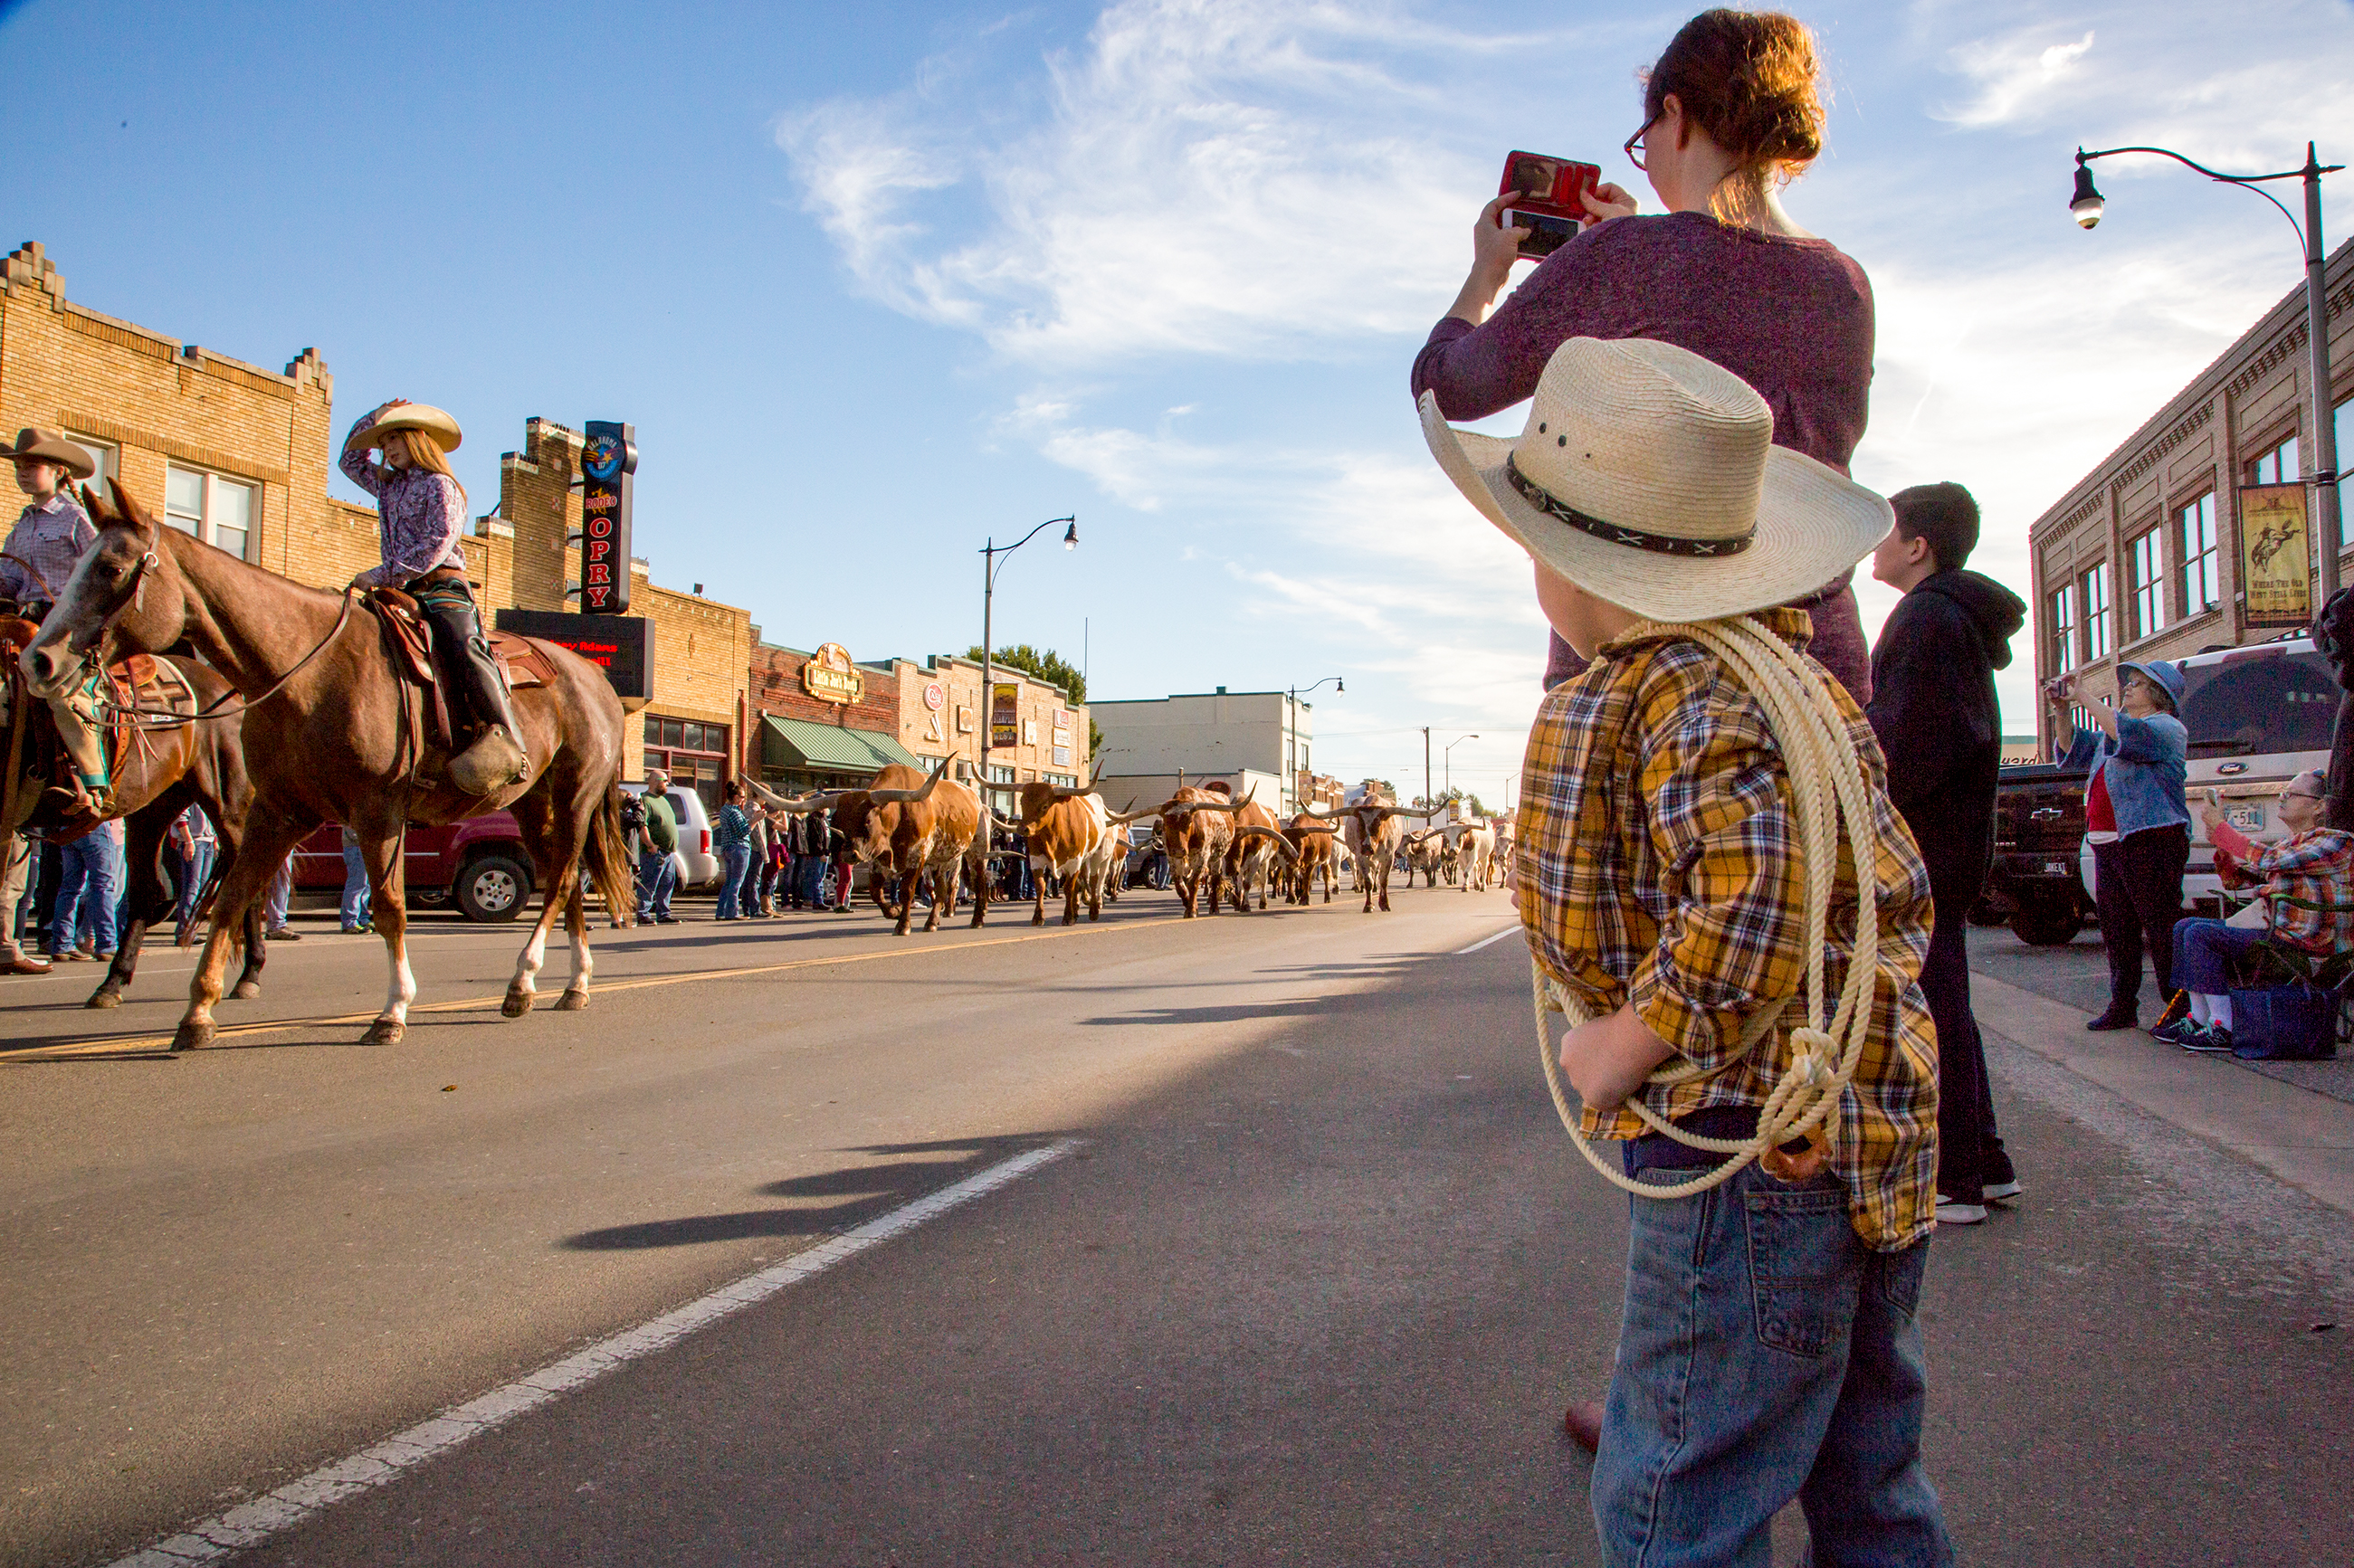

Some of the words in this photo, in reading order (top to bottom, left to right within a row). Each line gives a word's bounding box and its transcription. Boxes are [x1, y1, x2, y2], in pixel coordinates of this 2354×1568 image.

[587, 436, 617, 451] OKLAHOMA
[586, 496, 617, 509] RODEO
[588, 517, 613, 607] OPRY
[2252, 580, 2273, 588] WHERE
[2275, 580, 2289, 588] THE
[2291, 579, 2303, 587] OLD
[2249, 590, 2267, 599] WEST
[2269, 590, 2287, 598] STILL
[579, 641, 618, 652] Adams
[2221, 764, 2241, 773] Ford
